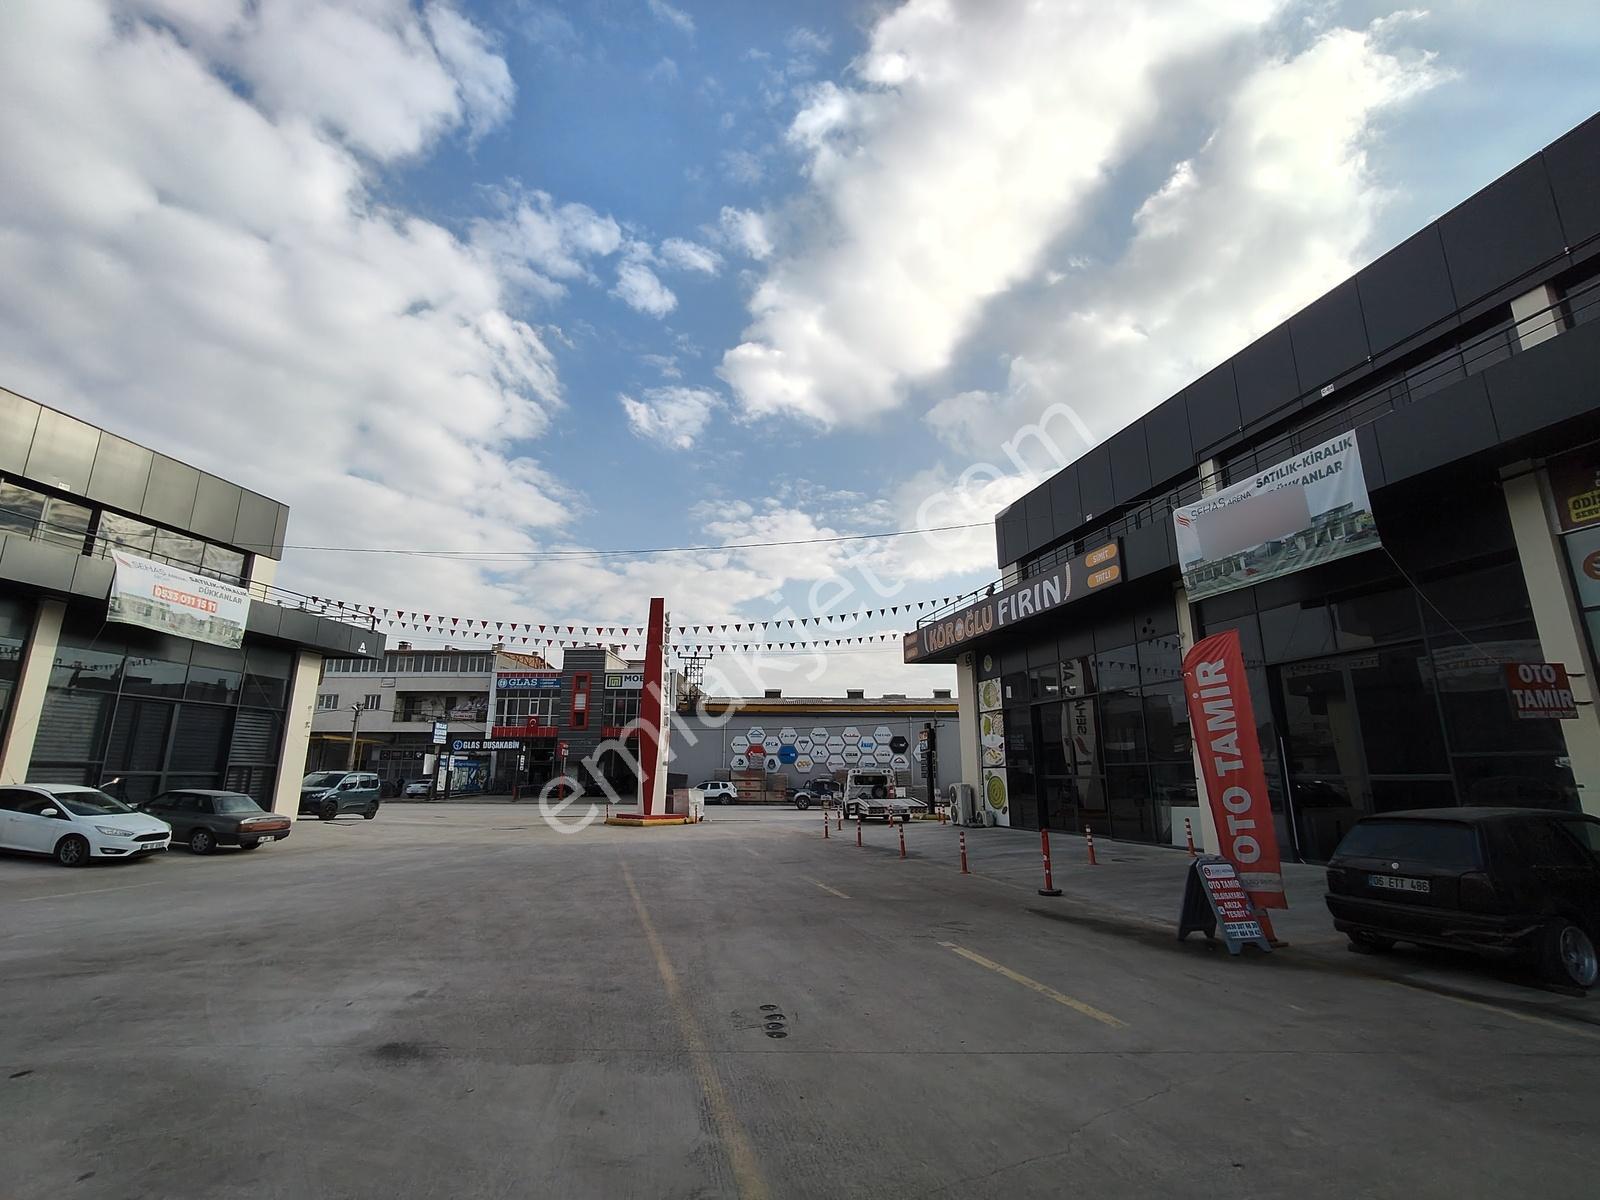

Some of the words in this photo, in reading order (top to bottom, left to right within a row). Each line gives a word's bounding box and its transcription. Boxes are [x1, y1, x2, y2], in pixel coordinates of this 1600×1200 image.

[1267, 460, 1343, 492] ANLAR
[1227, 491, 1252, 506] ARENA
[198, 586, 243, 605] DÜKKANLAR
[929, 605, 993, 651] KÖROĞLU
[997, 575, 1061, 625] FIRIN
[508, 678, 538, 687] GLAS
[1517, 664, 1557, 684] OTO
[1512, 684, 1575, 709] TAMİR
[1192, 658, 1244, 777] TAMİR
[463, 741, 480, 749] GLAS
[482, 739, 520, 750] DUŞAKABİN
[1222, 787, 1261, 864] OTO
[1207, 880, 1221, 889] OTO
